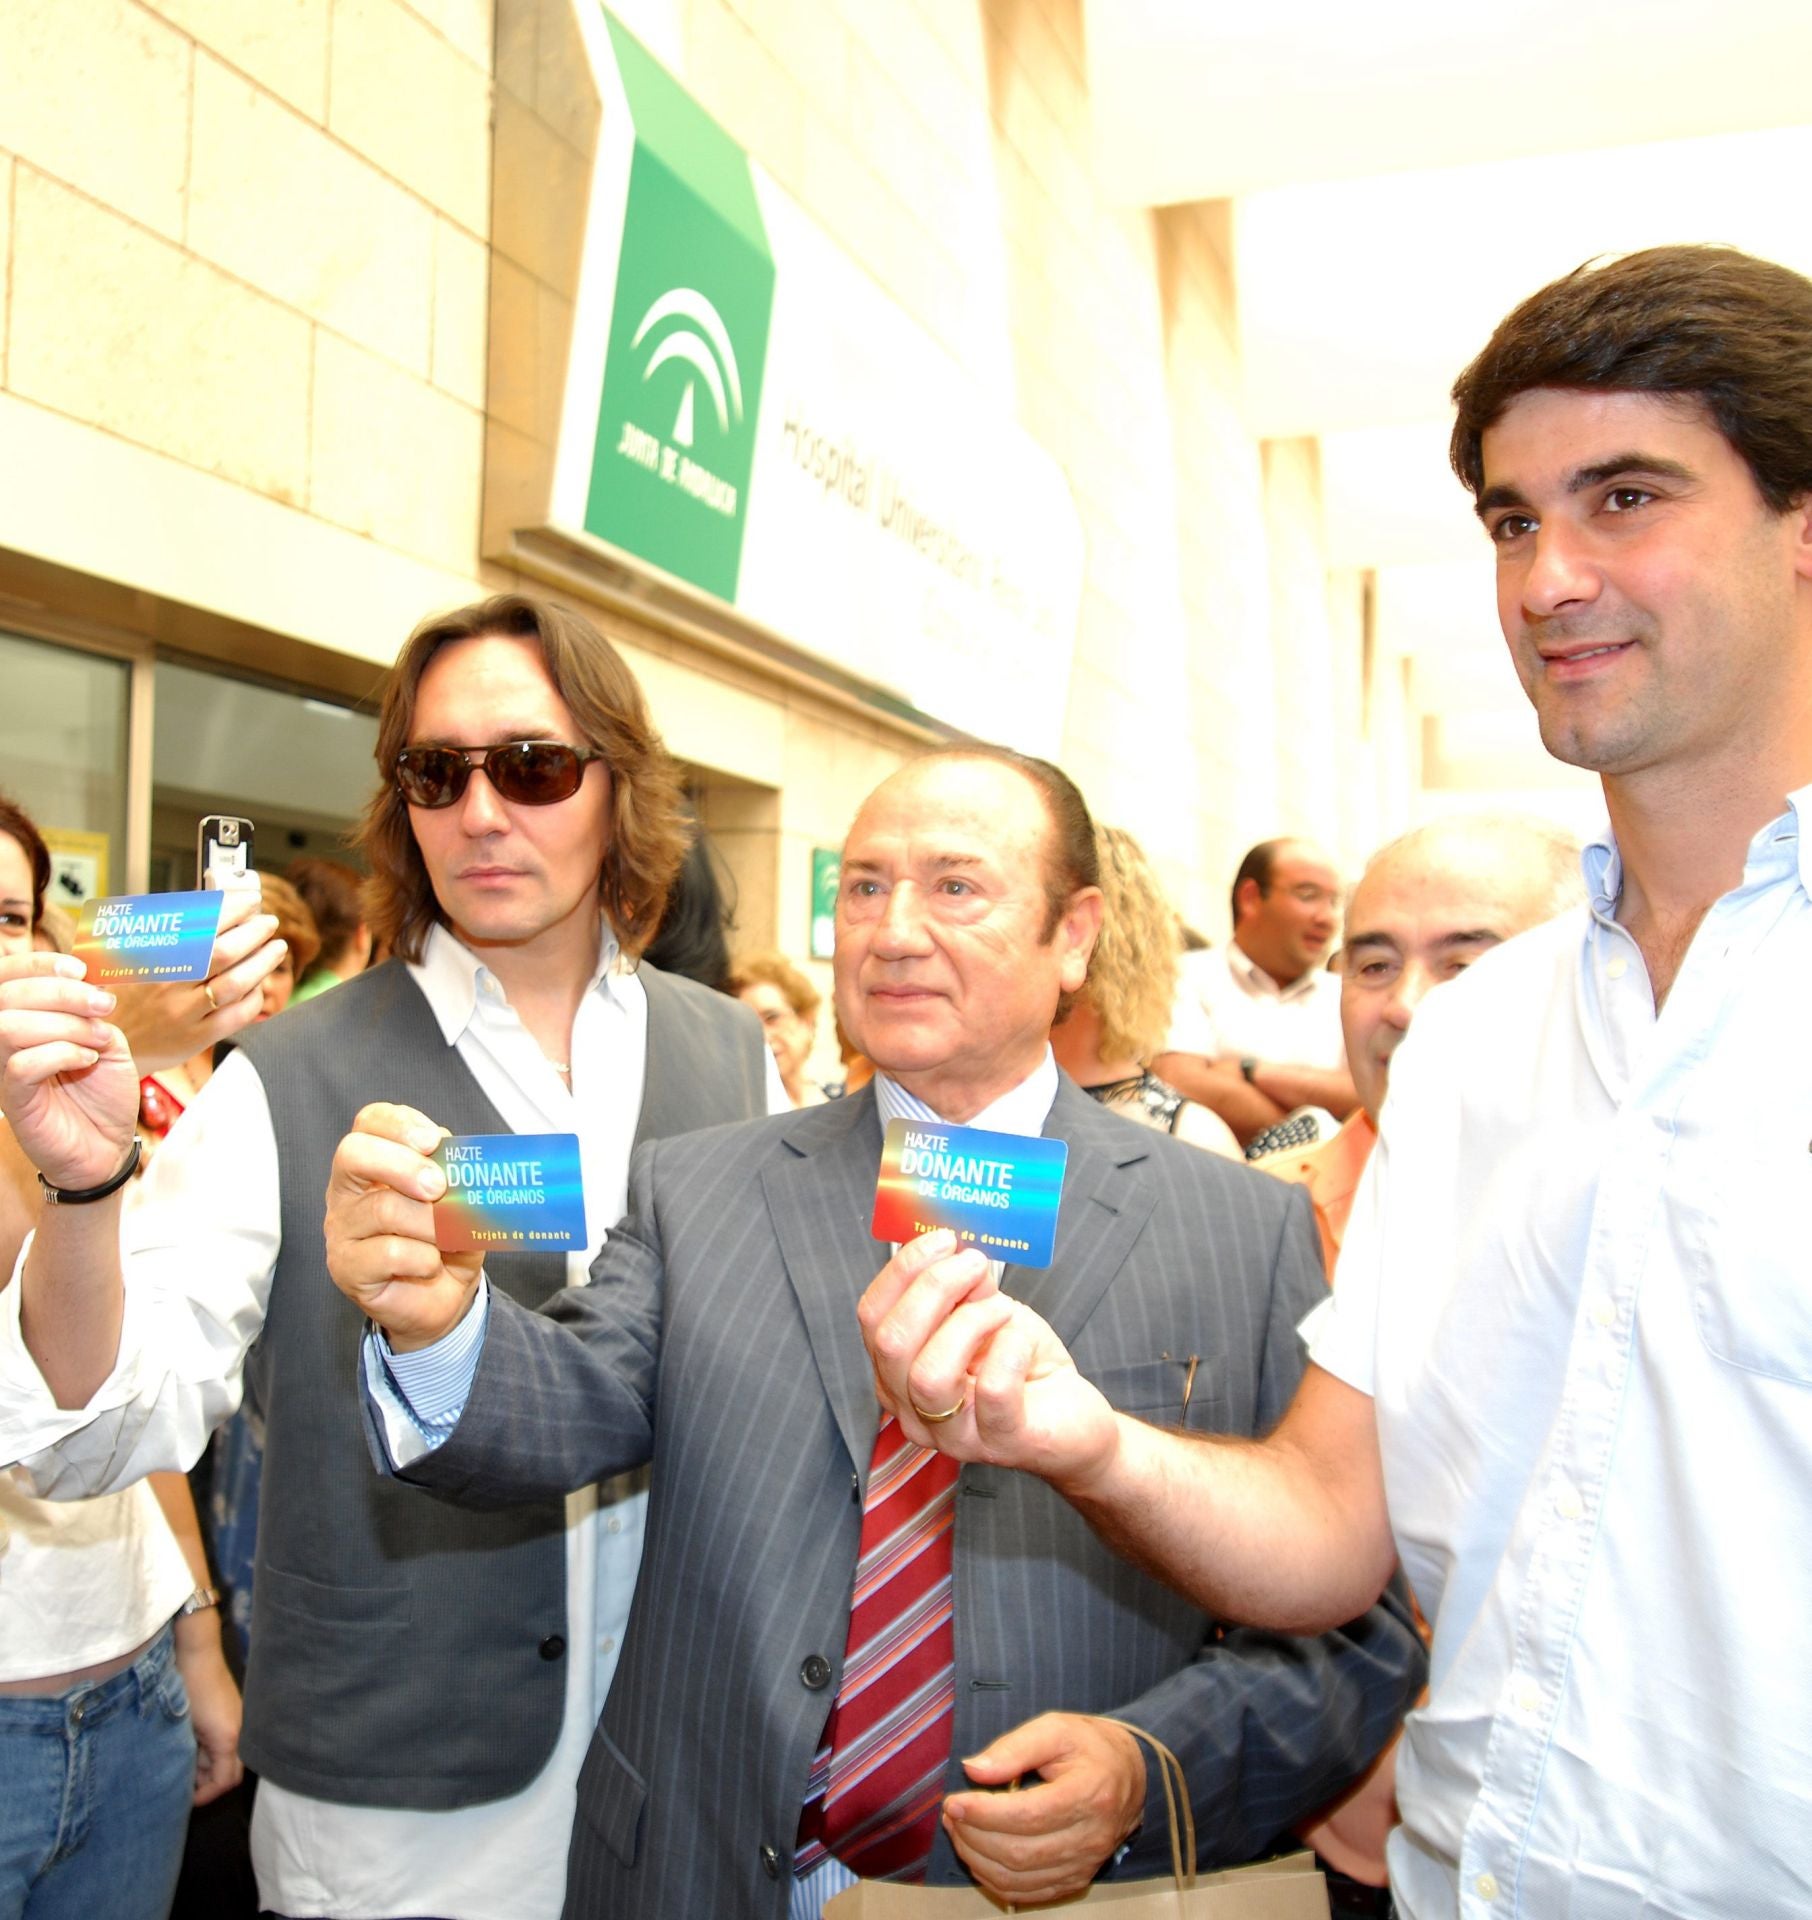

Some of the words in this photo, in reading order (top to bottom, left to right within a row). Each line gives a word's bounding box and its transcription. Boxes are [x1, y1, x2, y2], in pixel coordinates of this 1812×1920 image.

[659, 445, 679, 484] DE
[97, 904, 133, 918] HAZTE
[92, 912, 184, 937] DONANTE
[106, 937, 121, 950] DE
[124, 934, 179, 949] ÓRGANOS
[101, 968, 133, 978] Tarjeta
[138, 966, 149, 975] de
[153, 965, 192, 975] donante
[904, 1131, 949, 1153] HAZTE
[445, 1146, 483, 1161] HAZTE
[446, 1161, 544, 1187] DONANTE
[900, 1148, 1015, 1190] DONANTE
[467, 1190, 484, 1205] DE
[487, 1188, 545, 1205] ÓRGANOS
[918, 1180, 937, 1197] DE
[941, 1182, 1010, 1209] ÓRGANOS
[471, 1230, 508, 1241] Tarjeta
[512, 1230, 524, 1240] de
[529, 1230, 571, 1240] donante
[961, 1231, 975, 1242] de
[981, 1233, 1030, 1251] donante
